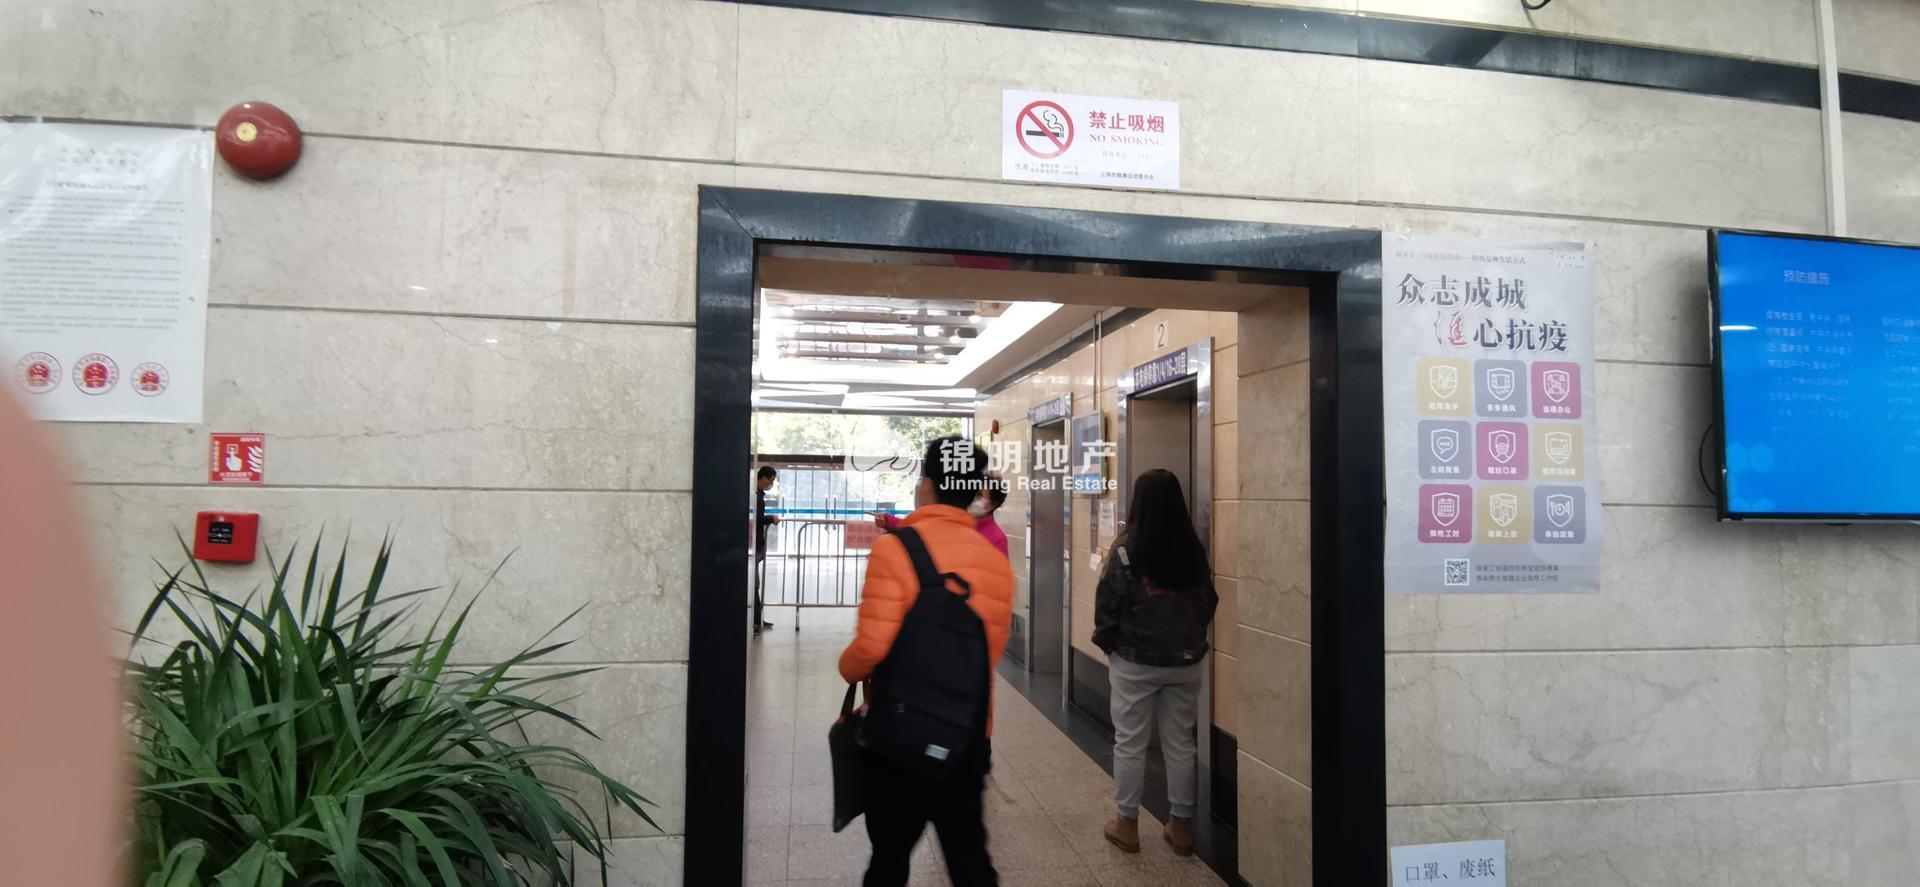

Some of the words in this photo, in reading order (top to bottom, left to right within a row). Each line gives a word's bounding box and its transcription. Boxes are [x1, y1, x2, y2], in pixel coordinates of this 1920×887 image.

[1089, 110, 1165, 133] 禁止吸烟
[1089, 133, 1106, 143] NO
[1110, 135, 1164, 146] SMOKING
[1783, 269, 1831, 286] 预防措施
[1396, 272, 1527, 311] 众志成城
[1157, 323, 1165, 348] 2
